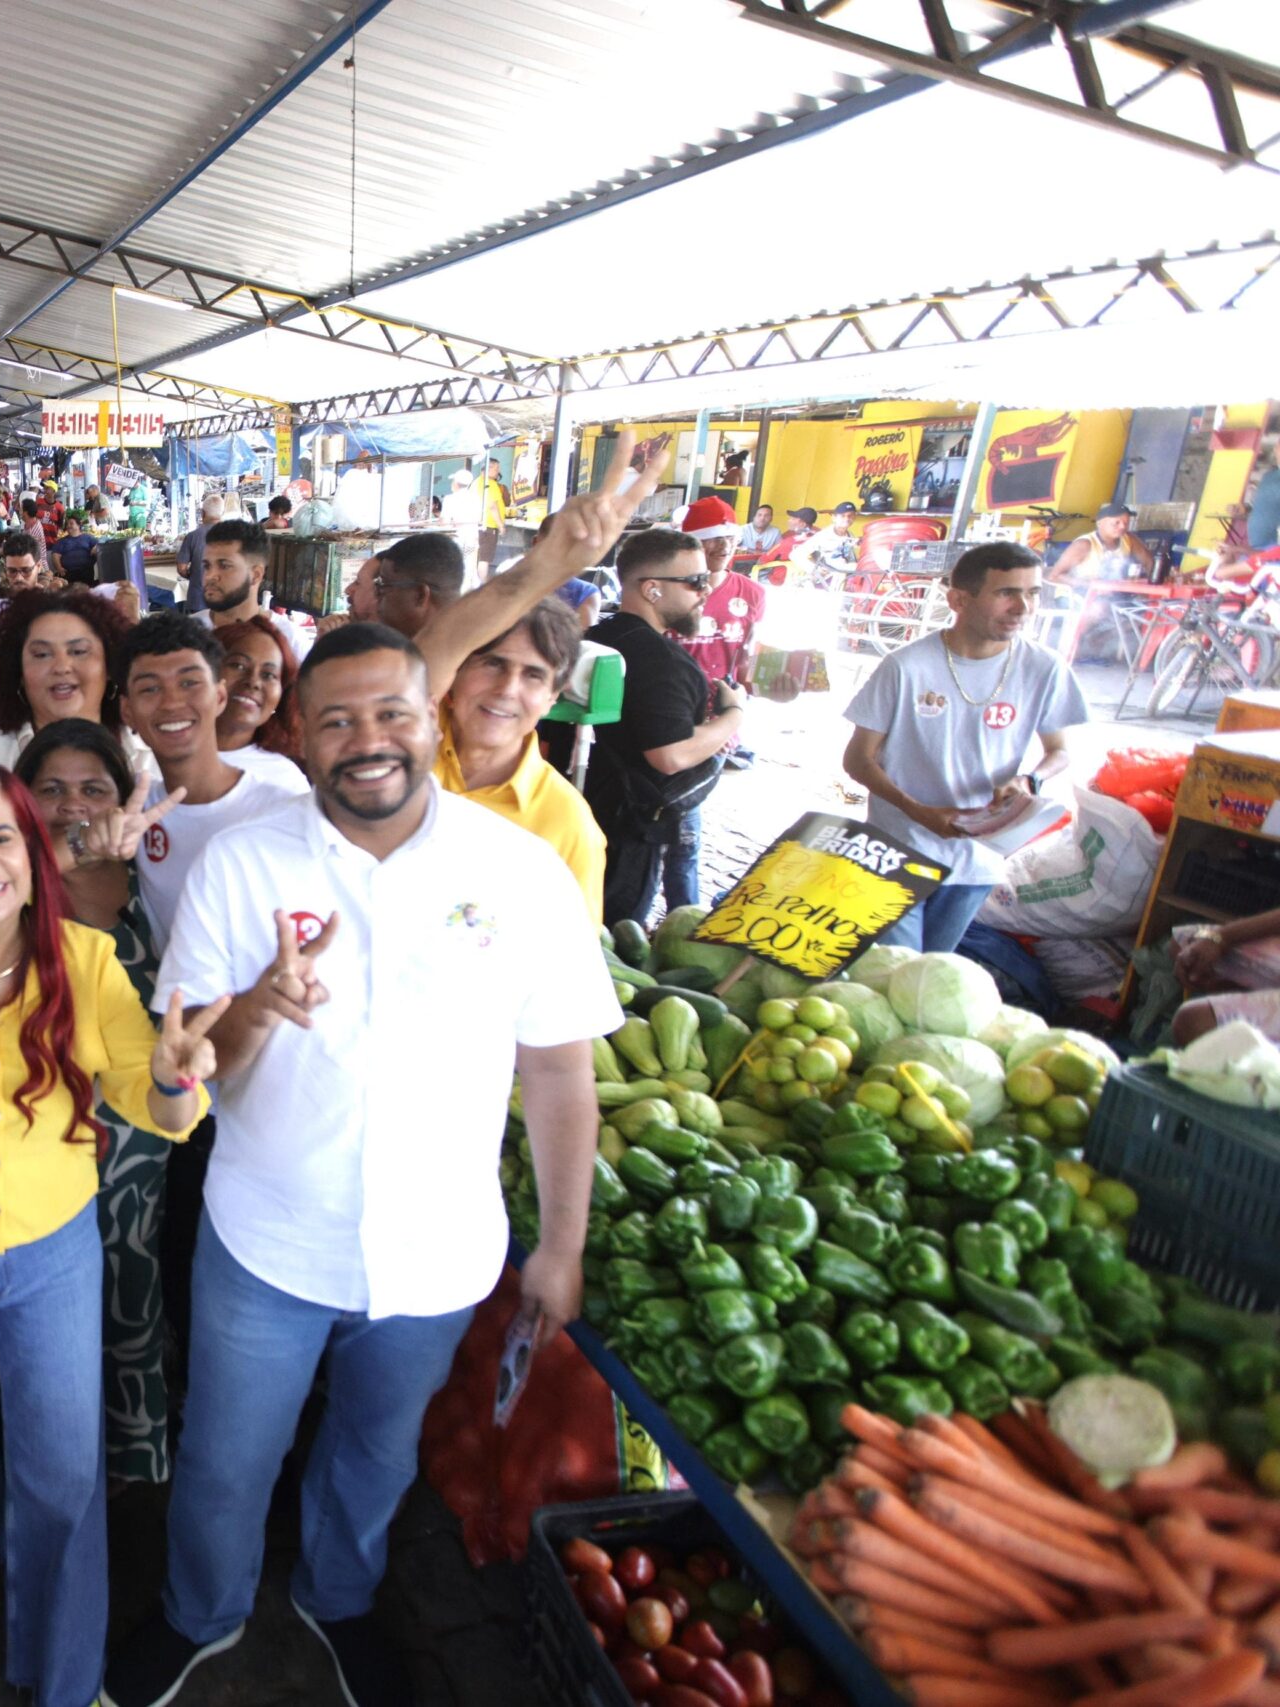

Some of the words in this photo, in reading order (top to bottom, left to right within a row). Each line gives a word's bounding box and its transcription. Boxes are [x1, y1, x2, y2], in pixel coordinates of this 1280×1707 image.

[112, 464, 139, 480] VENDE
[987, 706, 1014, 726] 13
[807, 836, 900, 875] FRIDAY
[817, 825, 908, 860] BLACK
